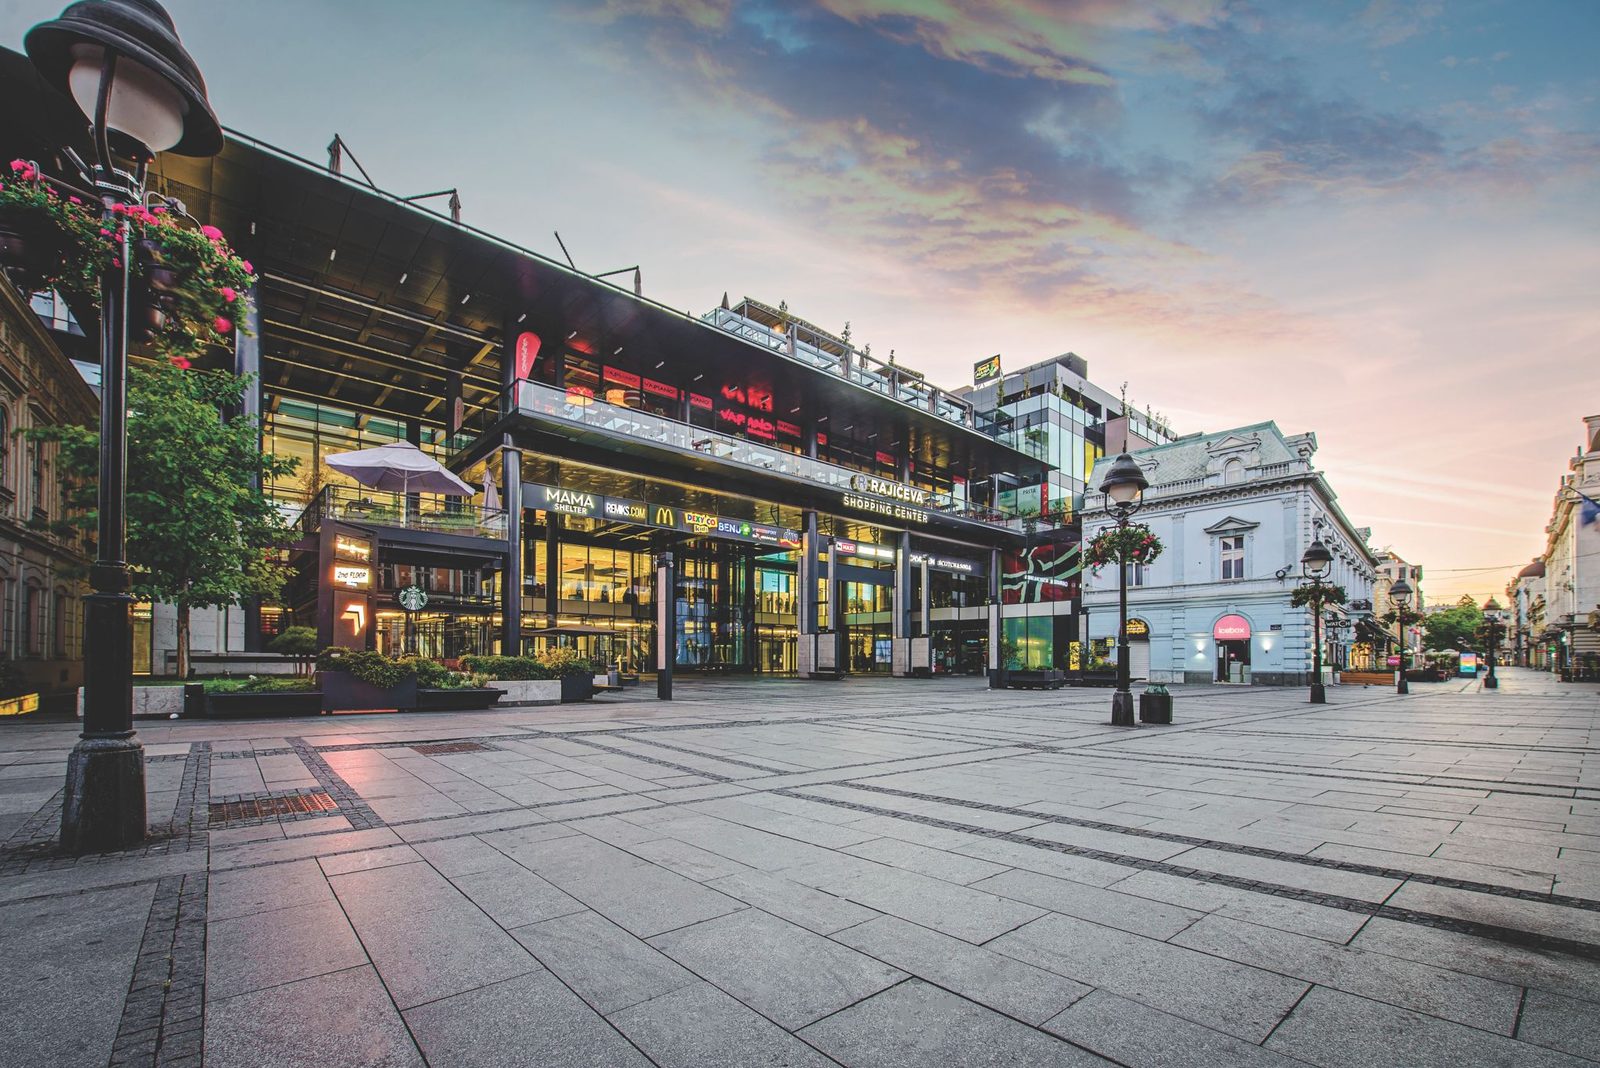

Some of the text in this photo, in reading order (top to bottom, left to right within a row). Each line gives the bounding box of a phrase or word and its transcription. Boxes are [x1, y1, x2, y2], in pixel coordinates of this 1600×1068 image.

[871, 479, 925, 504] RAJIĆEVA
[546, 487, 594, 509] MAMA
[554, 503, 588, 515] SHELTER
[843, 496, 928, 523] SHOPPING CENTER
[687, 514, 715, 526] DEXY CO
[350, 571, 367, 579] FLOOR
[1325, 620, 1350, 628] WATCH
